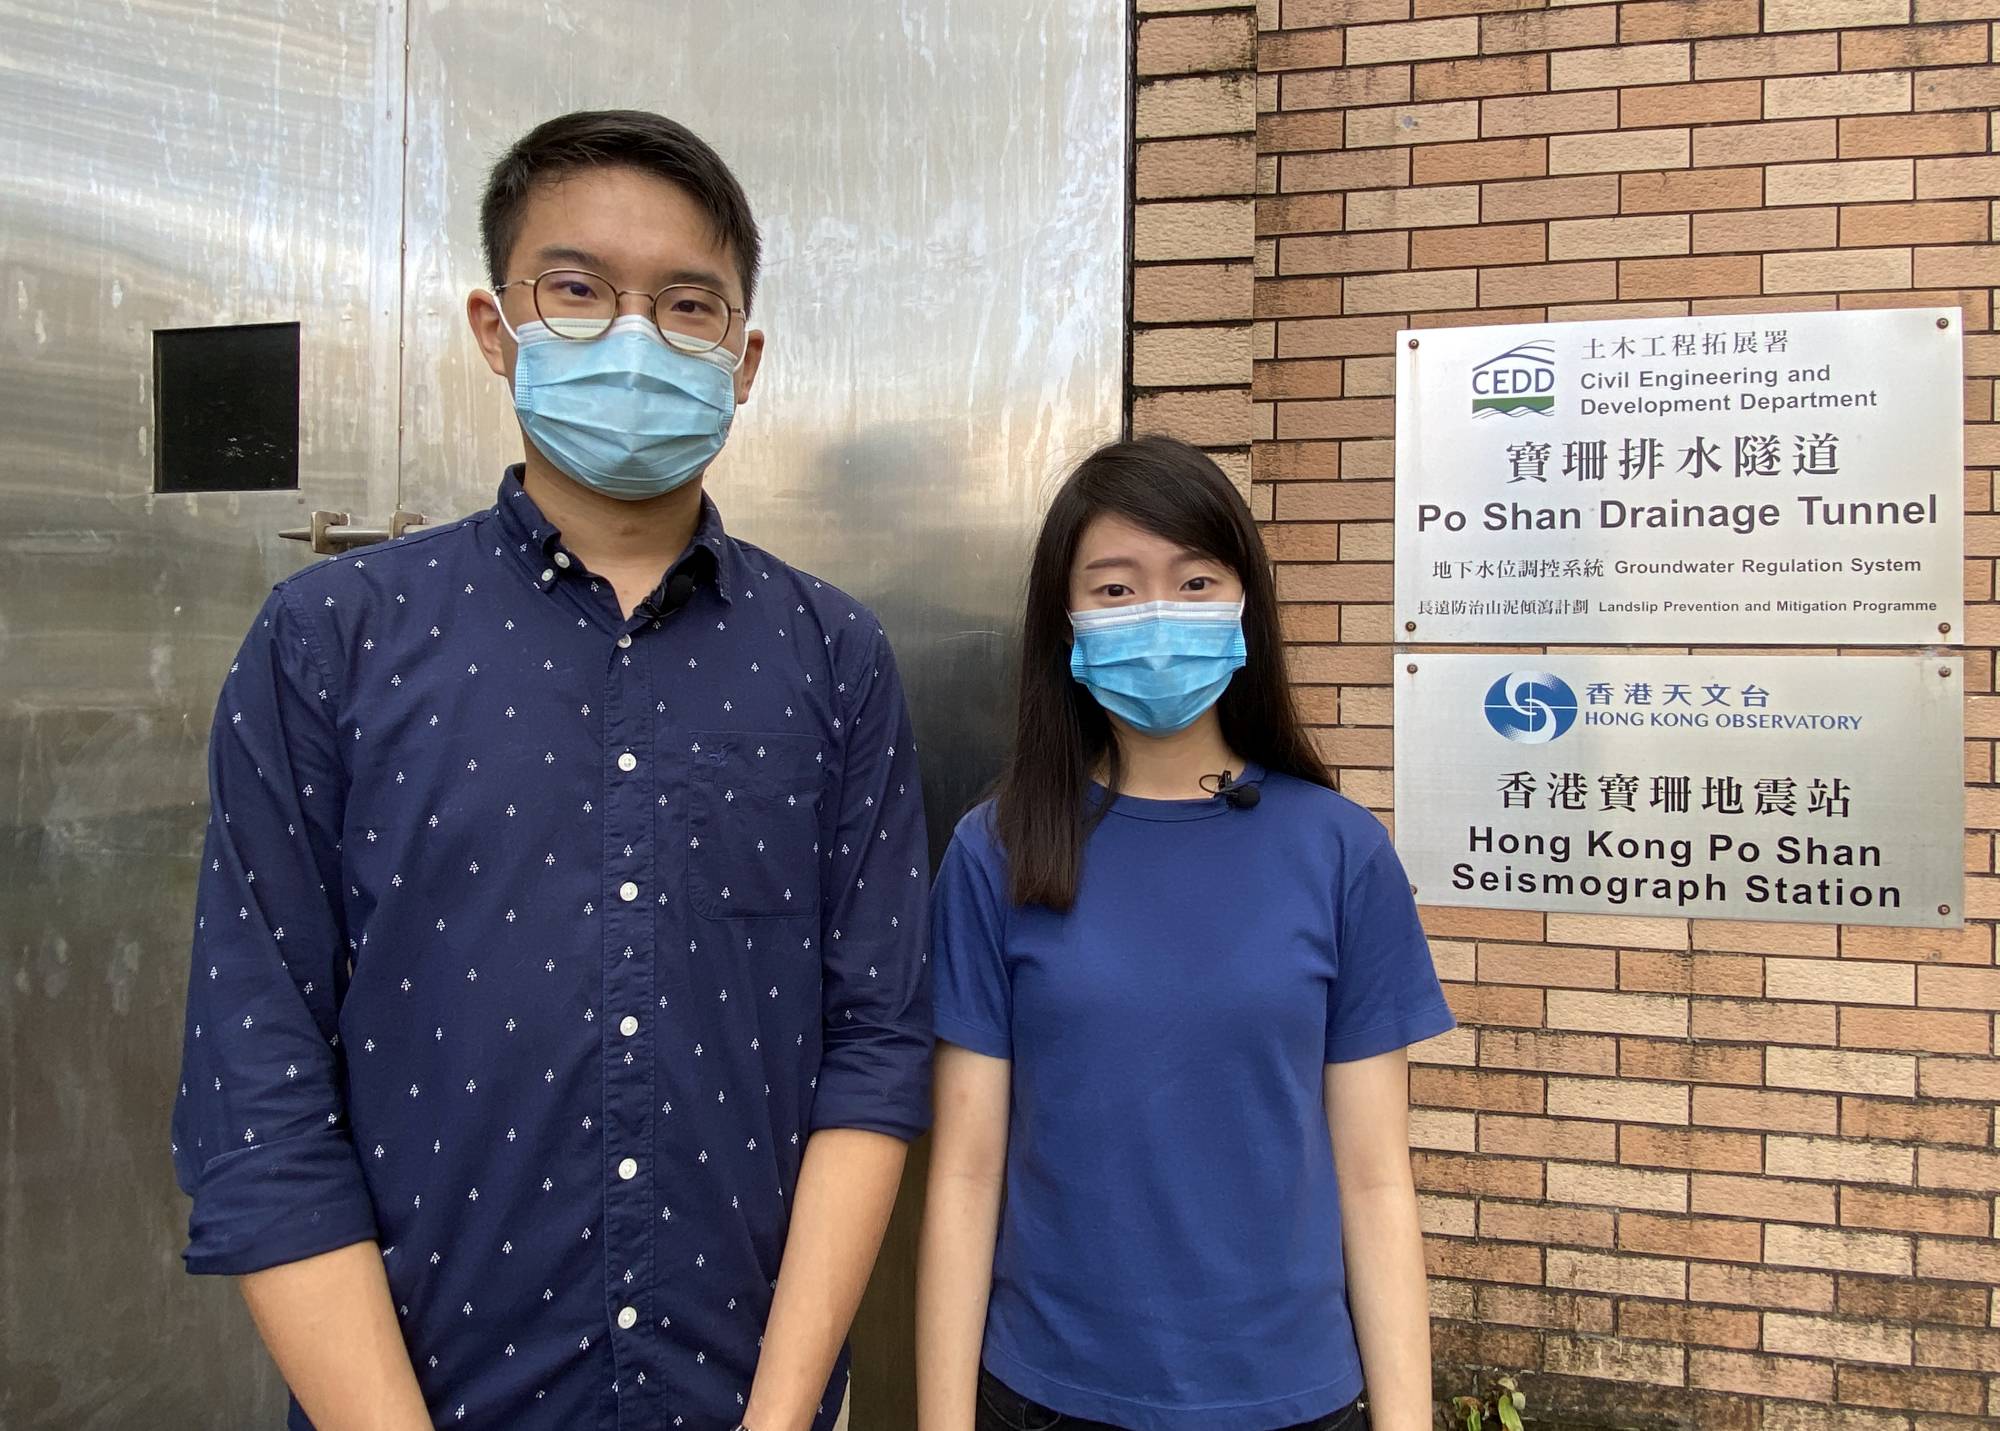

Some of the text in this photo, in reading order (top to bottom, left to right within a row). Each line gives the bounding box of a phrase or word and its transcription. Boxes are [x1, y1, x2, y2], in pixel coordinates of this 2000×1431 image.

[1581, 329, 1789, 361] 土木工程拓展署
[1472, 367, 1555, 395] CEDD
[1580, 365, 1830, 390] Civil Engineering and
[1580, 390, 1877, 416] Development Department
[1505, 433, 1841, 484] 寶珊排水隧道
[1418, 495, 1937, 533] Po Shan Drainage Tunnel
[1432, 560, 1605, 580] 地下水位調控系統
[1614, 557, 1921, 576] Groundwater Regulation System
[1418, 599, 1589, 616] 長遠防治山泥傾瀉計劃
[1599, 600, 1937, 614] Landslip Prevention and Mitigation Programme
[1585, 682, 1771, 708] 香港天文台
[1585, 711, 1862, 730] HONG KONG OBSERVATORY
[1496, 772, 1851, 818] 香港寶珊地震站
[1469, 826, 1881, 867] Hong Kong Po Shan
[1452, 864, 1901, 908] Seismograph Station
